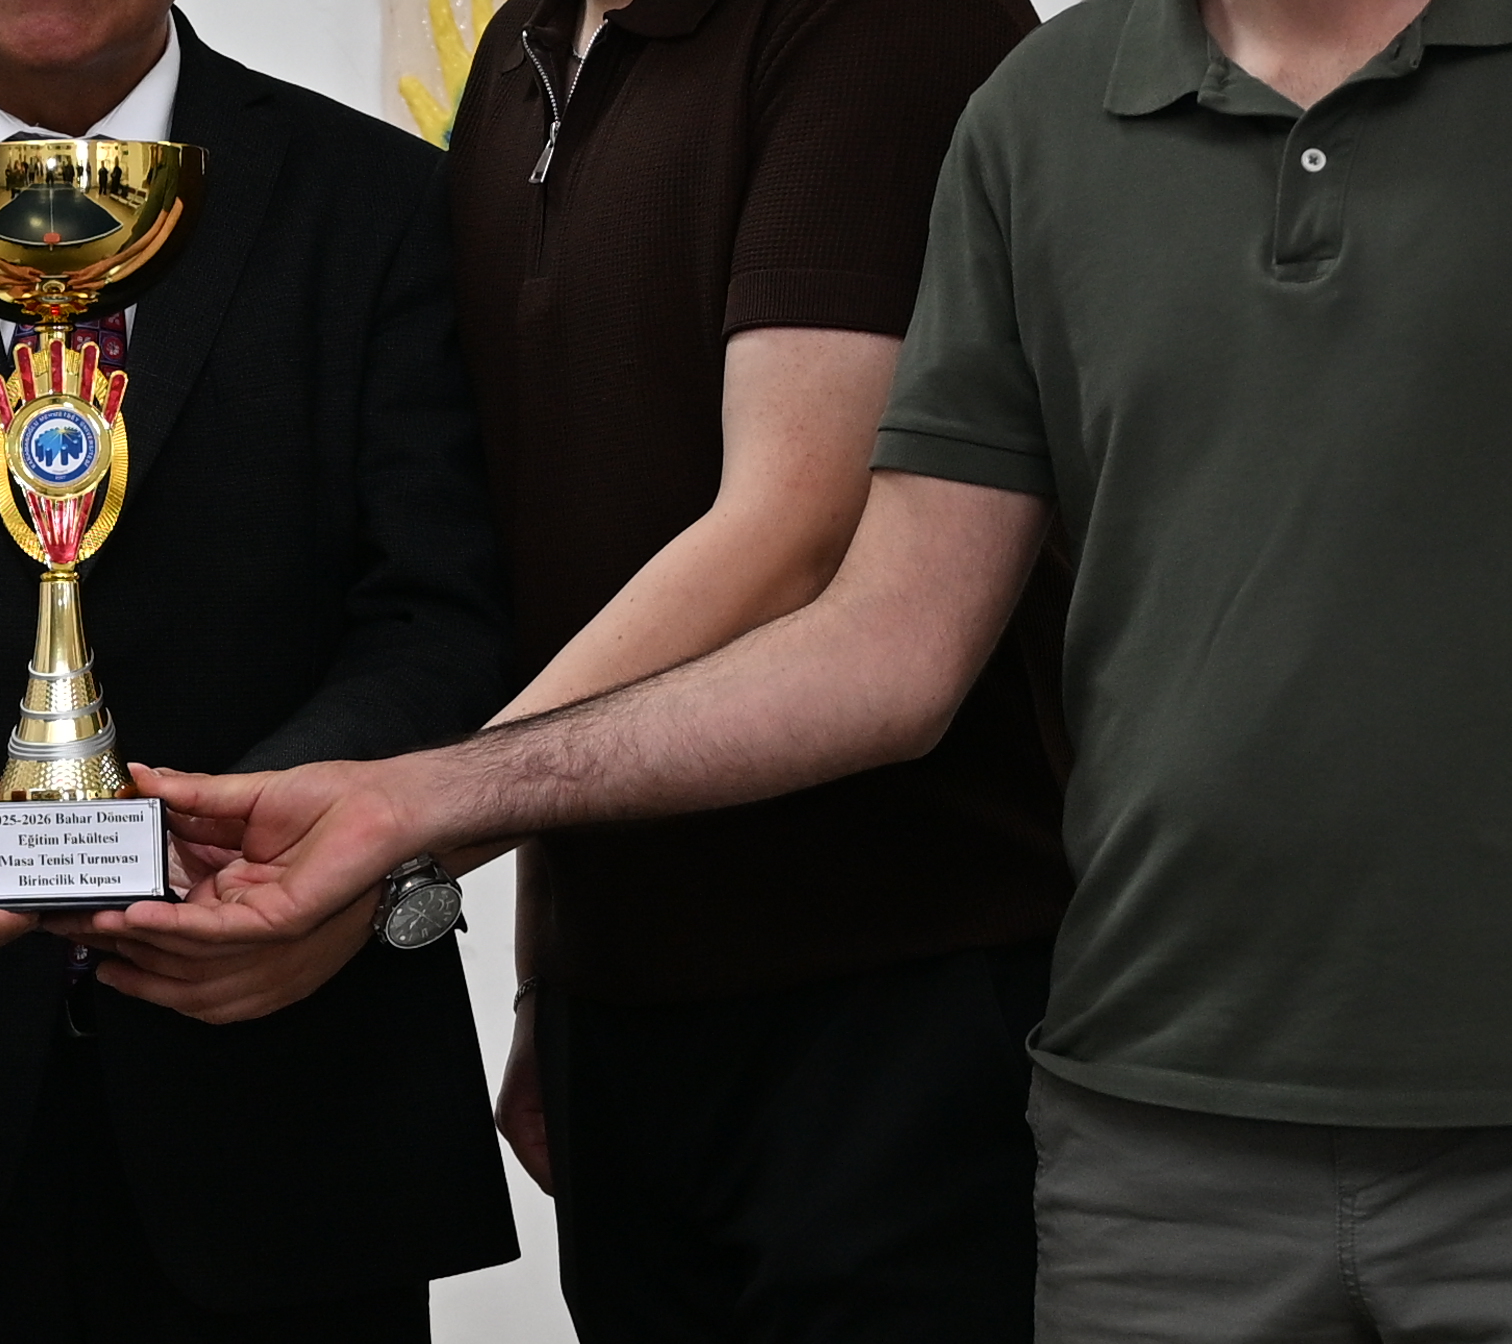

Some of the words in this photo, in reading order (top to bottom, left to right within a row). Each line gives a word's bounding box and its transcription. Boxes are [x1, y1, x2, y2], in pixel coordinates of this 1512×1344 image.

[55, 812, 92, 825] Bahar
[96, 810, 144, 824] Dönemi
[18, 833, 59, 848] Eğitim
[63, 831, 119, 845] Fakültesi
[0, 855, 34, 868] Masa
[38, 853, 74, 866] Tenisi
[77, 852, 139, 865] Turnuvası
[18, 874, 75, 887] Birincilik
[79, 872, 121, 888] Kupası
